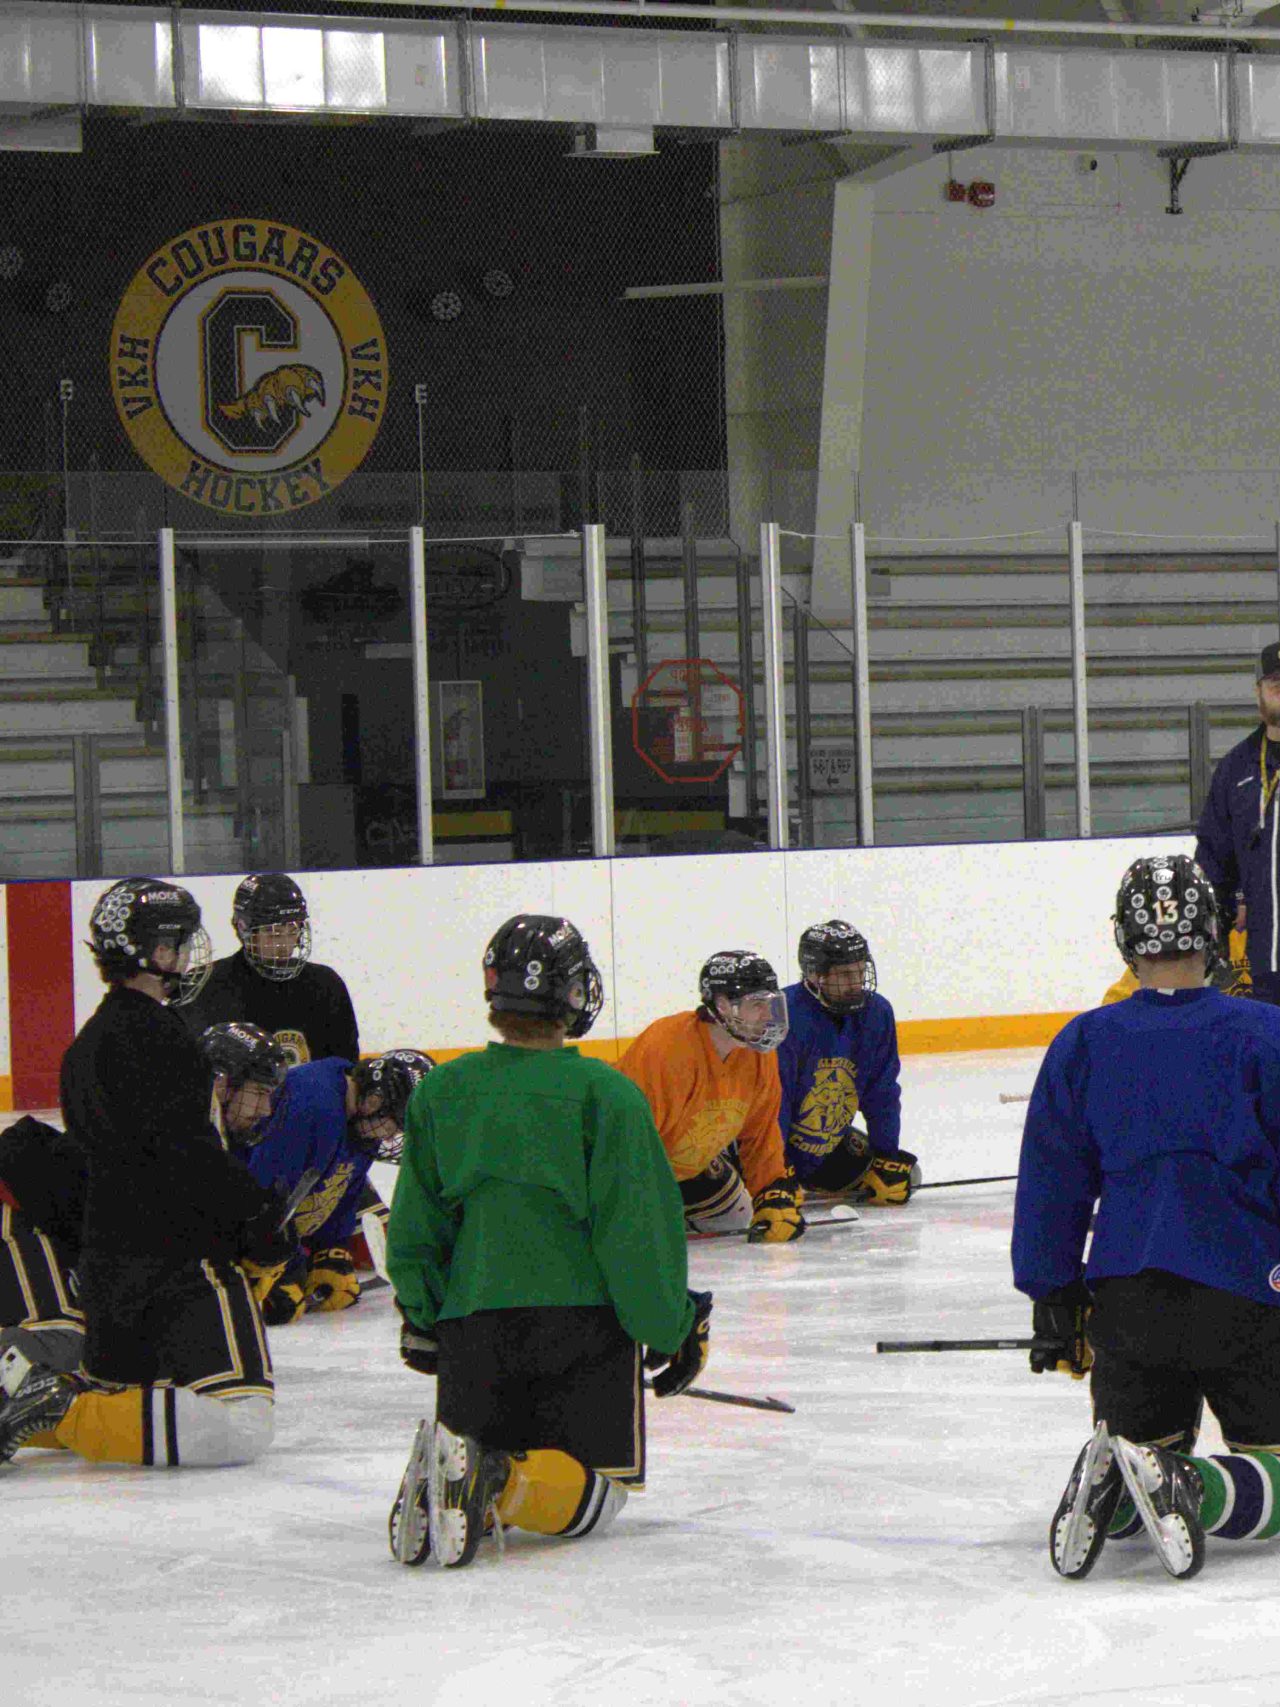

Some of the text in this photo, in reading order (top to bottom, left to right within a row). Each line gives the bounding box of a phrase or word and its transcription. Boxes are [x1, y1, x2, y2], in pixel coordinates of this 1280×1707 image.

[145, 223, 346, 297] COUGARS
[116, 333, 153, 421] VKH
[347, 337, 383, 423] VKH
[180, 457, 330, 513] HOCKEY
[1152, 899, 1179, 926] 13
